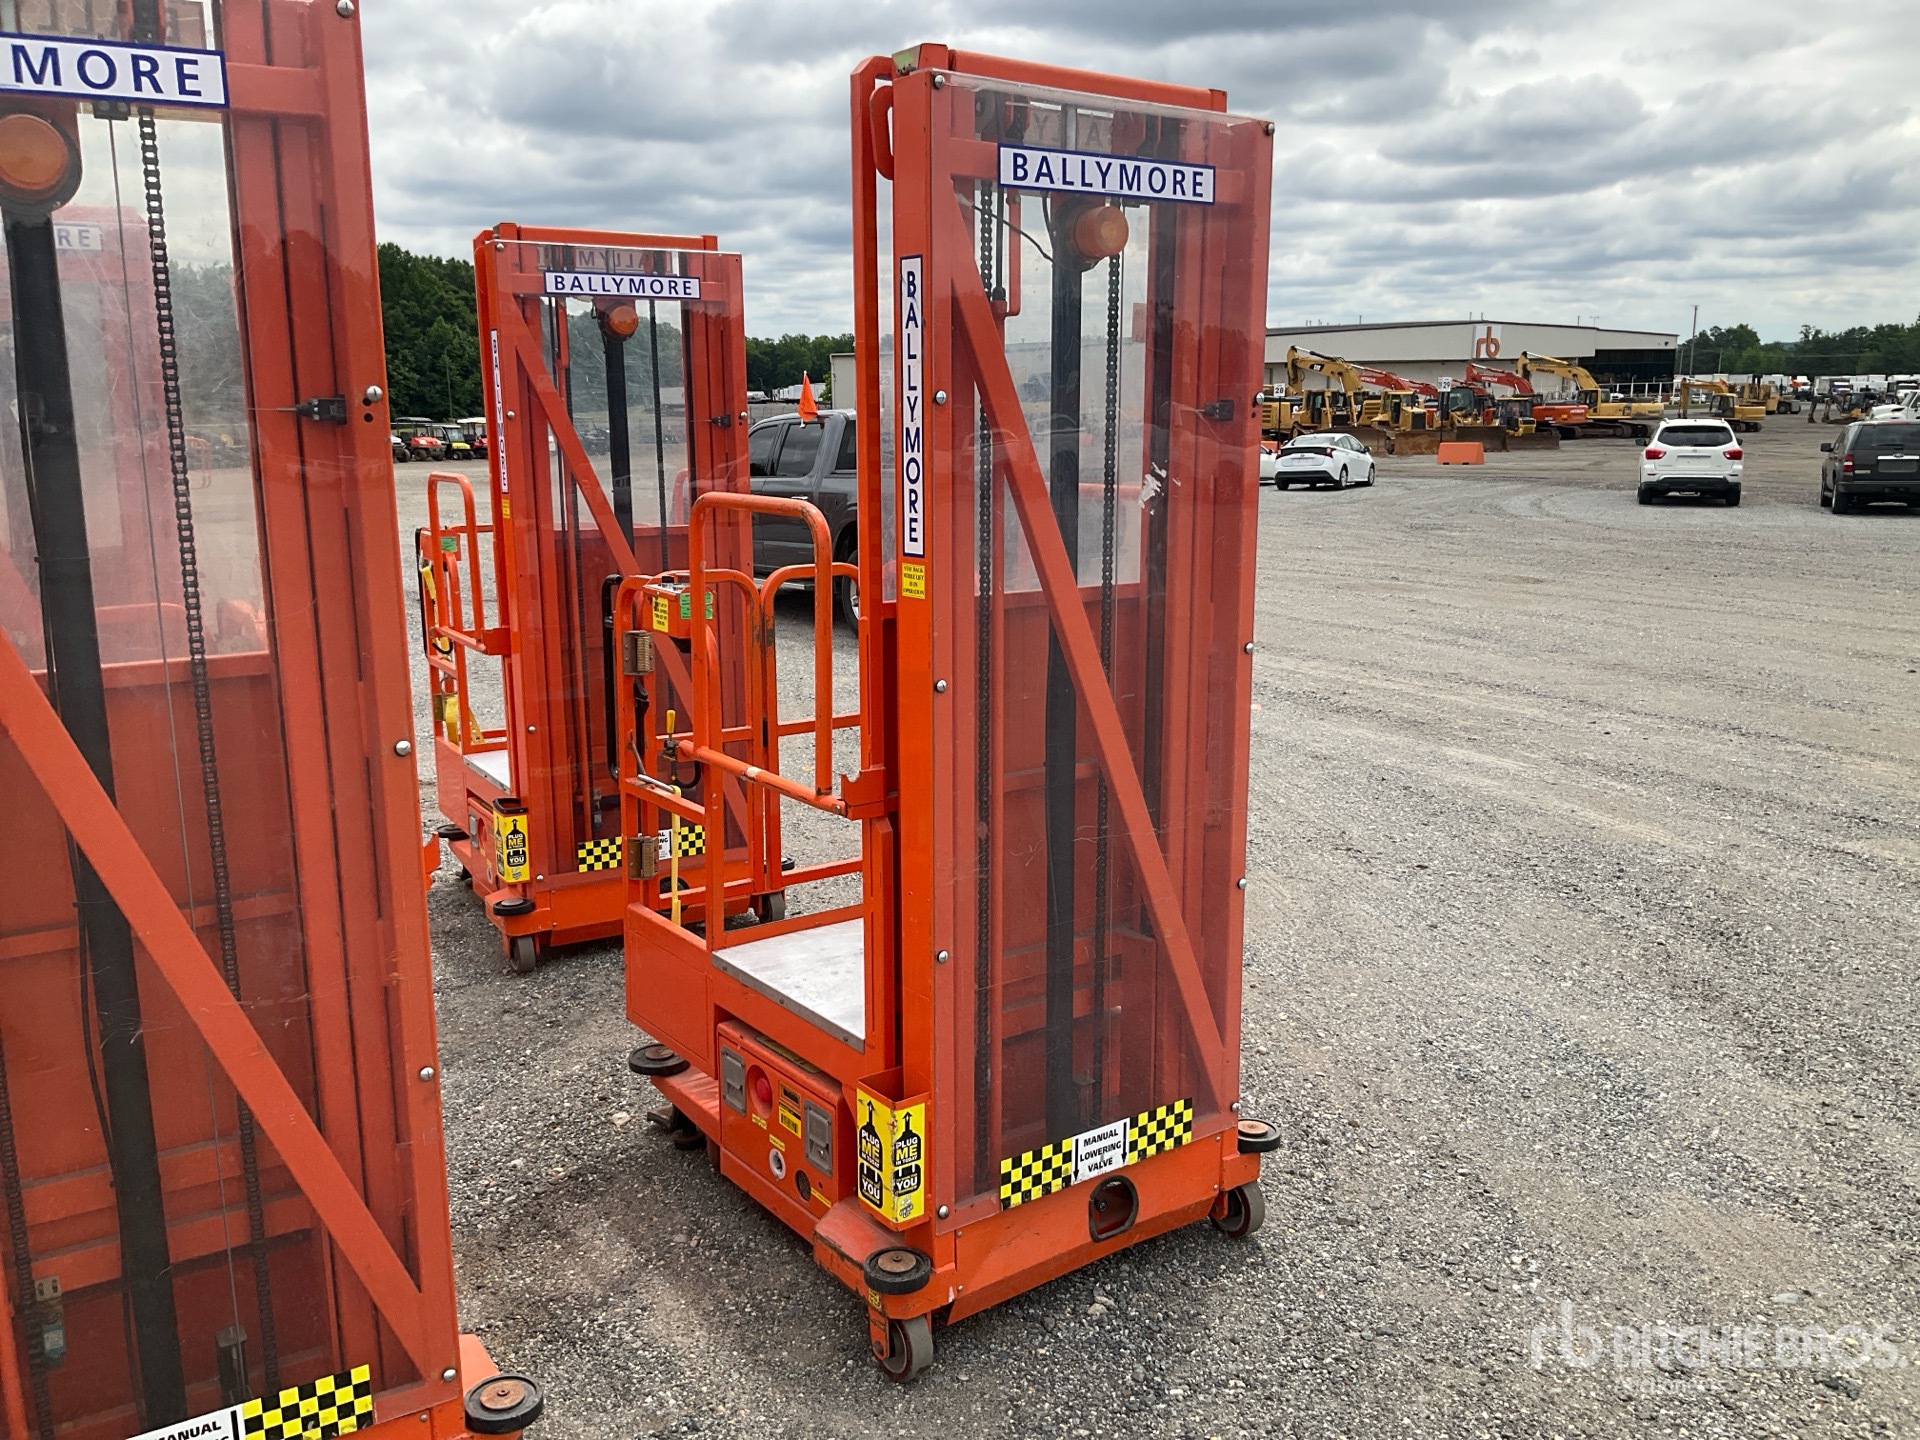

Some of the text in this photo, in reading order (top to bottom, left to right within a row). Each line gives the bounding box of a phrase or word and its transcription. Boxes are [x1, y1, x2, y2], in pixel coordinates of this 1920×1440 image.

[1011, 151, 1204, 198] BALLYMORE
[553, 274, 693, 297] BALLYMORE
[1476, 326, 1500, 358] rb
[905, 270, 921, 543] BALLYMORE
[508, 838, 524, 847] ME
[509, 856, 525, 864] YOU
[861, 1129, 880, 1149] PLUG
[895, 1136, 918, 1150] PLUG
[1083, 1129, 1119, 1147] MANUAL
[861, 1138, 880, 1162] ME
[896, 1143, 918, 1161] ME
[1080, 1141, 1122, 1162] LOWERING
[1087, 1157, 1113, 1173] VALVE
[862, 1178, 880, 1200] YOU
[896, 1176, 918, 1191] YOU
